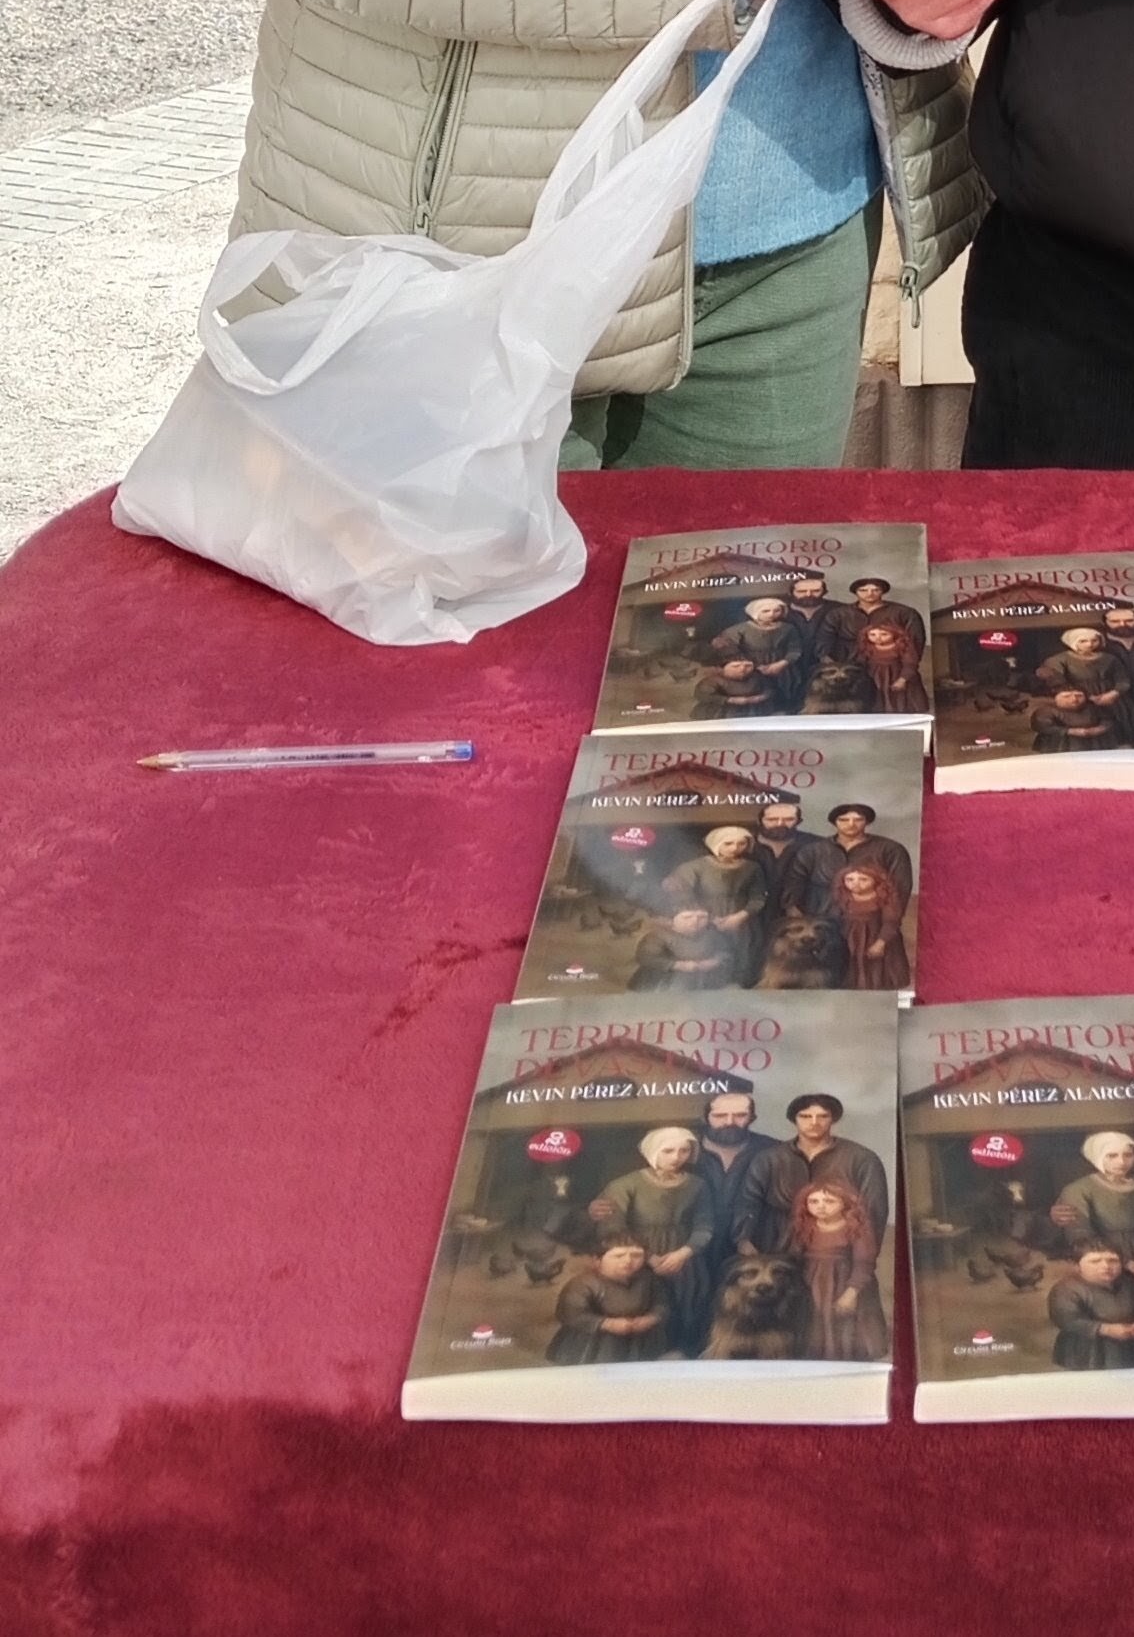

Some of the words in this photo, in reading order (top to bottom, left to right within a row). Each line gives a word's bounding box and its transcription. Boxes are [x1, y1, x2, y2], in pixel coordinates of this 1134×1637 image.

[651, 537, 842, 565] TERRITORIO
[644, 580, 690, 592] KEVIN
[952, 608, 997, 620] KEVIN
[604, 749, 824, 772] TERRITORIO
[592, 795, 643, 808] KEVIN
[702, 791, 780, 805] ALARCÓN
[520, 1017, 782, 1053] TERRITORIO
[514, 1047, 772, 1083] DEVASTADO
[505, 1085, 565, 1104] KEVIN
[570, 1082, 633, 1100] PÉREZ
[636, 1077, 730, 1097] ALARCÓN
[933, 1091, 993, 1109] KEVIN
[997, 1086, 1058, 1104] PÉREZ
